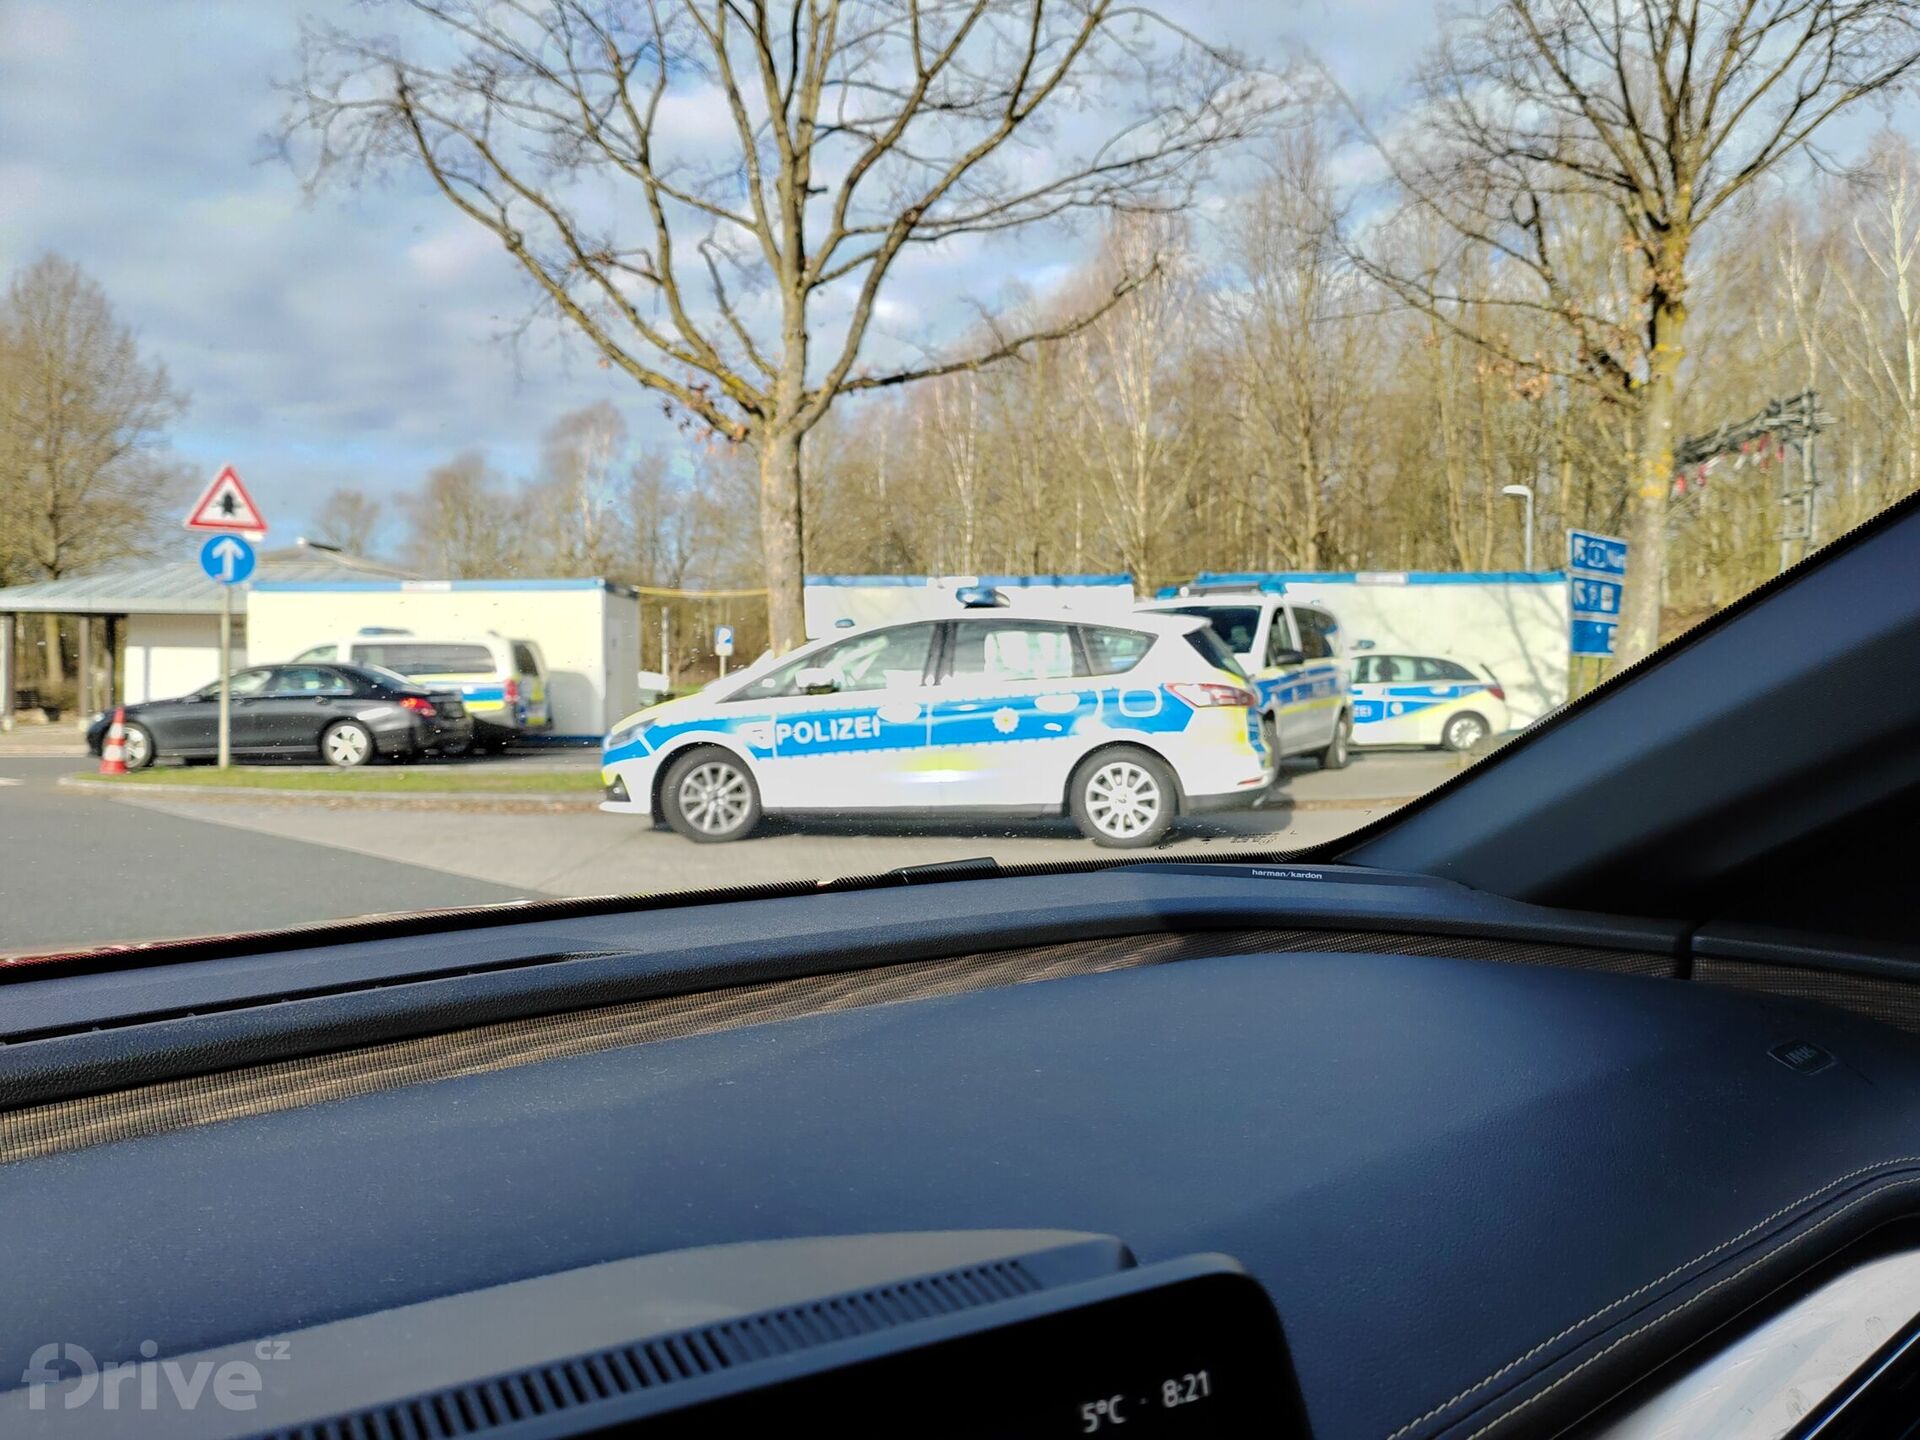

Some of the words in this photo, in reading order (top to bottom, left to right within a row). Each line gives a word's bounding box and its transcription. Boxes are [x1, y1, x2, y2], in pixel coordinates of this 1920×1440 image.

[776, 715, 881, 746] POLIZEI
[1251, 869, 1323, 880] harman/kardon
[1162, 1369, 1211, 1408] 8:21
